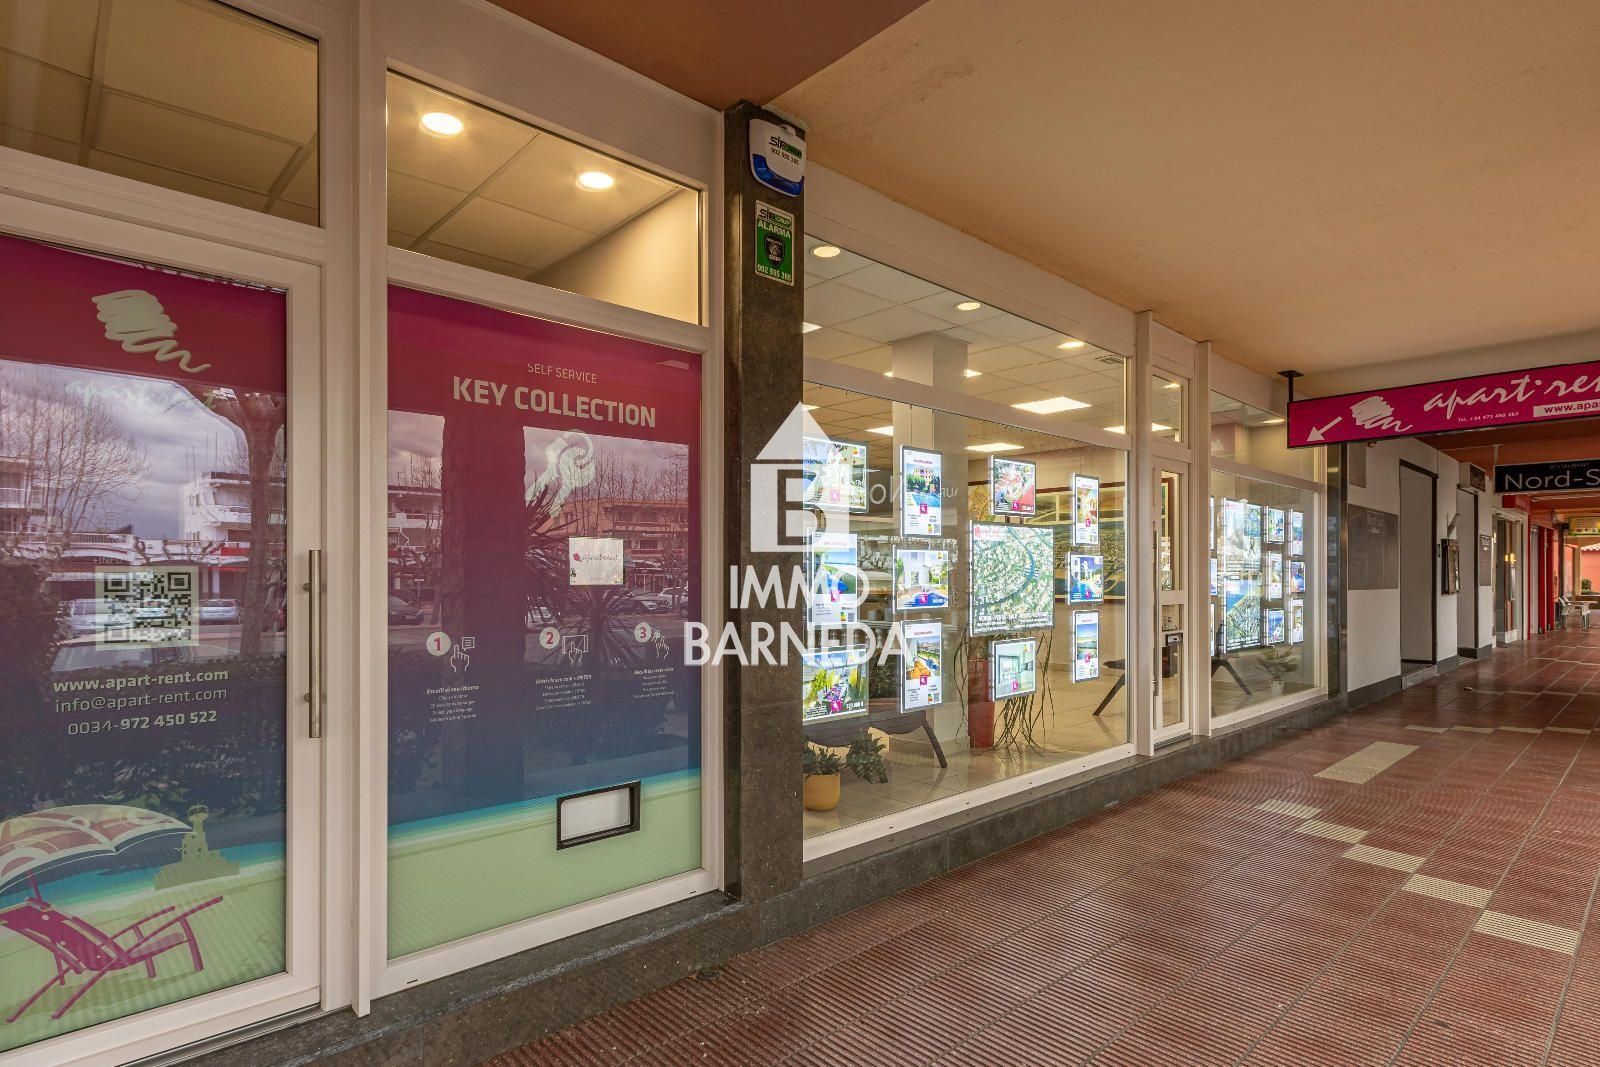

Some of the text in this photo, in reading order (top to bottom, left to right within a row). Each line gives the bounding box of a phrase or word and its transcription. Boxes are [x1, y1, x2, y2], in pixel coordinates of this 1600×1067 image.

[758, 220, 791, 238] ALARMA
[757, 264, 769, 274] 902
[528, 362, 598, 384] SELF SERVICE
[453, 375, 656, 428] KEY COLLECTION
[1544, 401, 1600, 413] www.apa
[546, 632, 554, 645] 2
[640, 627, 647, 639] 3
[433, 638, 441, 651] 1
[53, 670, 229, 693] www.apart-rent.com
[56, 688, 227, 713] info@apart-rent.com
[68, 710, 217, 735] 0034-972 450 522
